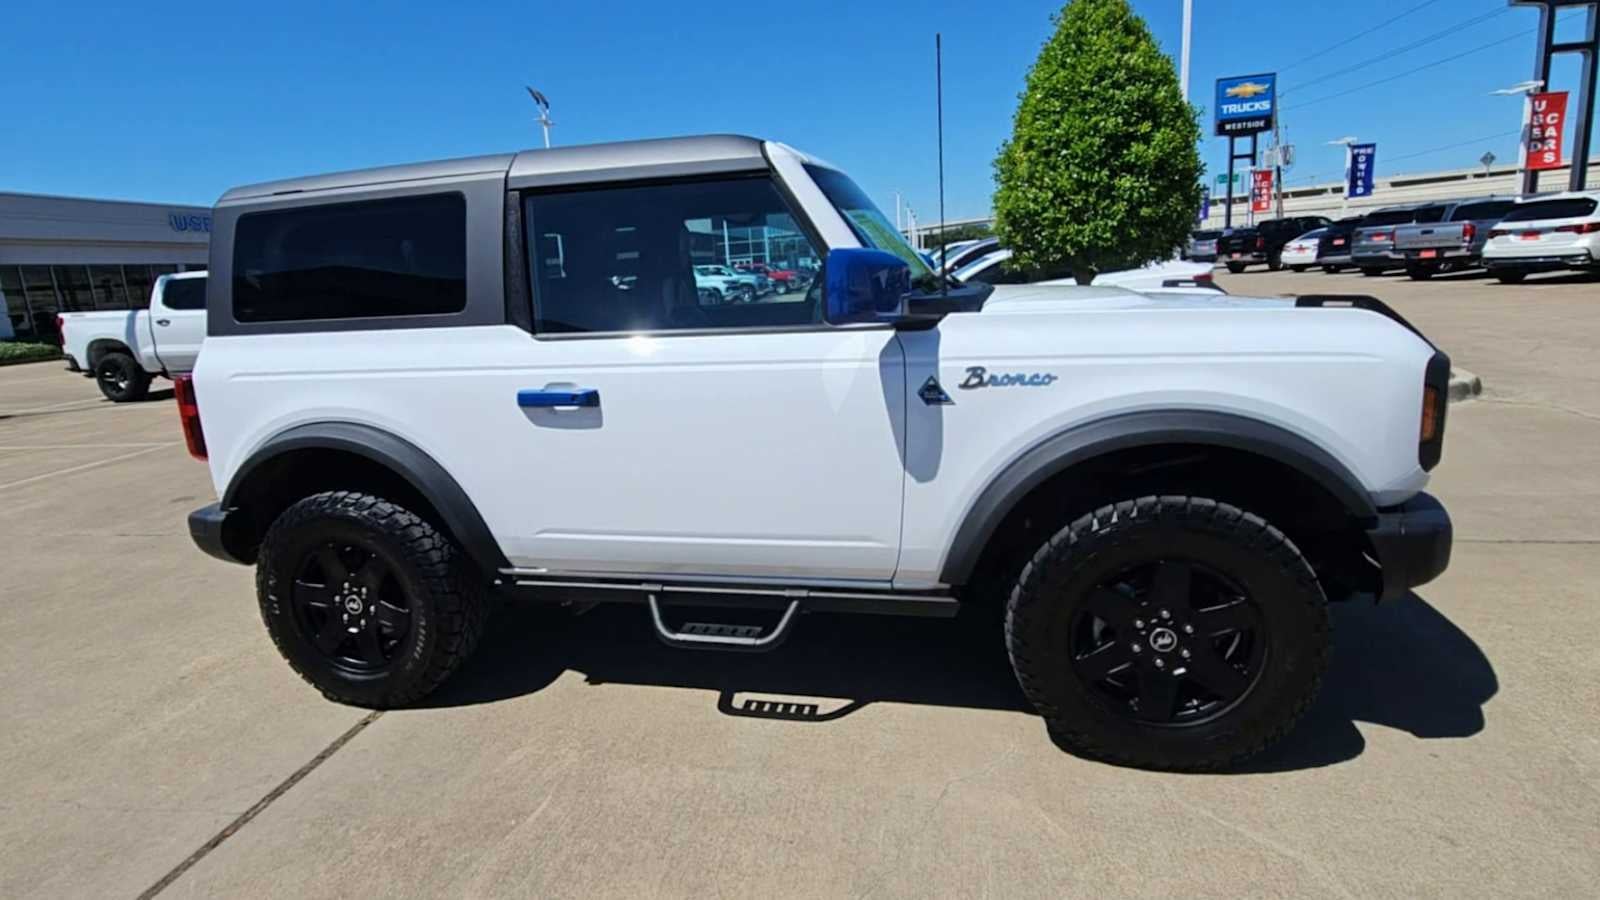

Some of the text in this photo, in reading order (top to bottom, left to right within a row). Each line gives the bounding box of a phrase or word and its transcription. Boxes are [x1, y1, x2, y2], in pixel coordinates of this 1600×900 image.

[1221, 100, 1270, 114] TRUCKS
[1225, 120, 1265, 130] WESTSIDE
[1530, 99, 1547, 153] USED
[1543, 112, 1559, 164] CARS
[958, 366, 1058, 389] Bronco
